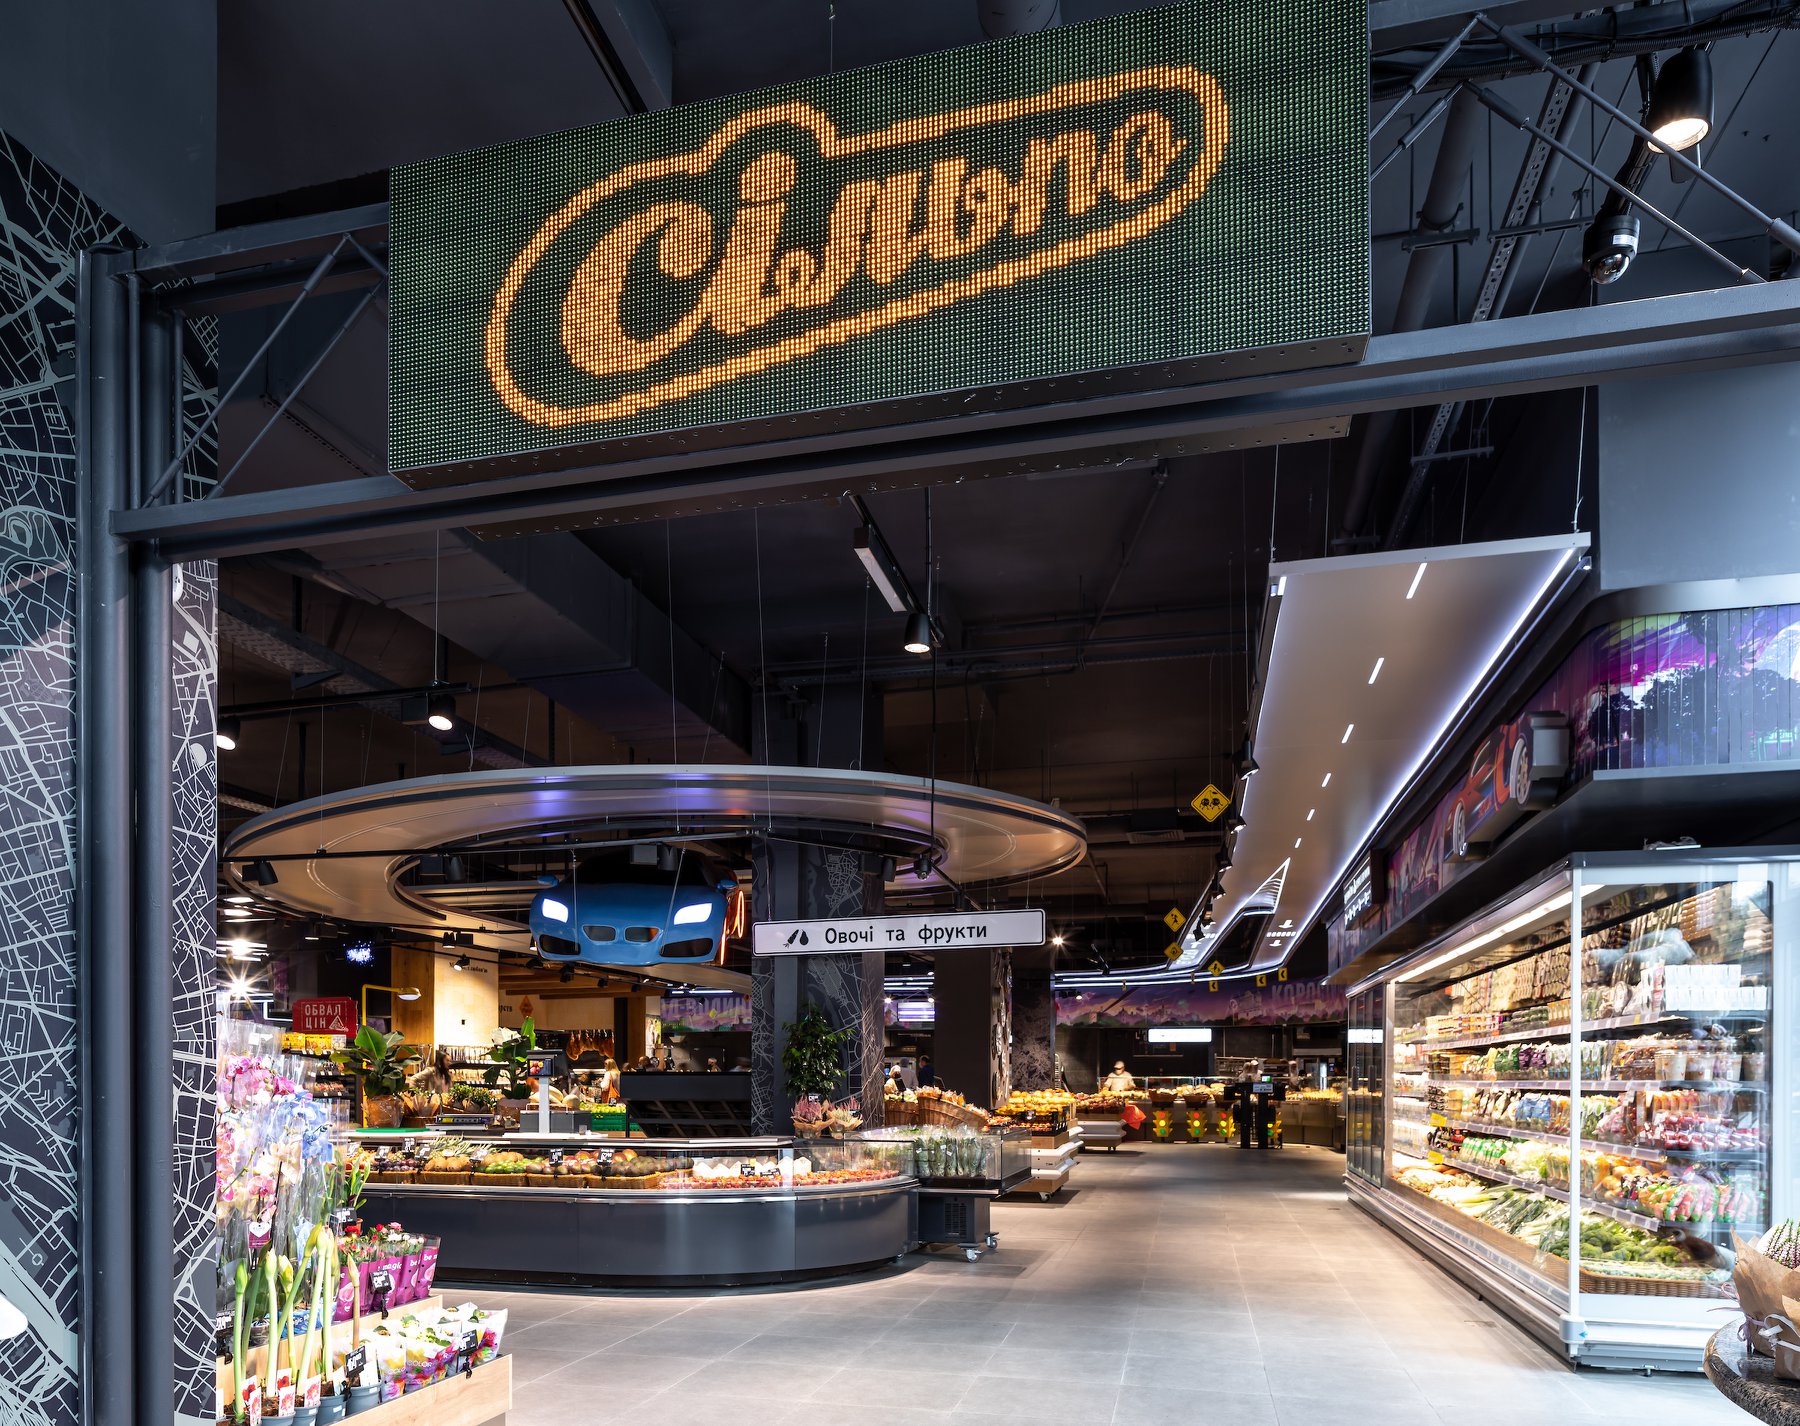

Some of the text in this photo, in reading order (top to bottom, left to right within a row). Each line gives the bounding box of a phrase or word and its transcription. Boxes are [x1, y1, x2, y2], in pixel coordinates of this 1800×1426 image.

[561, 109, 1187, 376] Сільпо
[824, 924, 988, 945] Овочі та фрукти
[304, 1004, 341, 1016] ОБВАЛ
[305, 1016, 326, 1030] ЦІН
